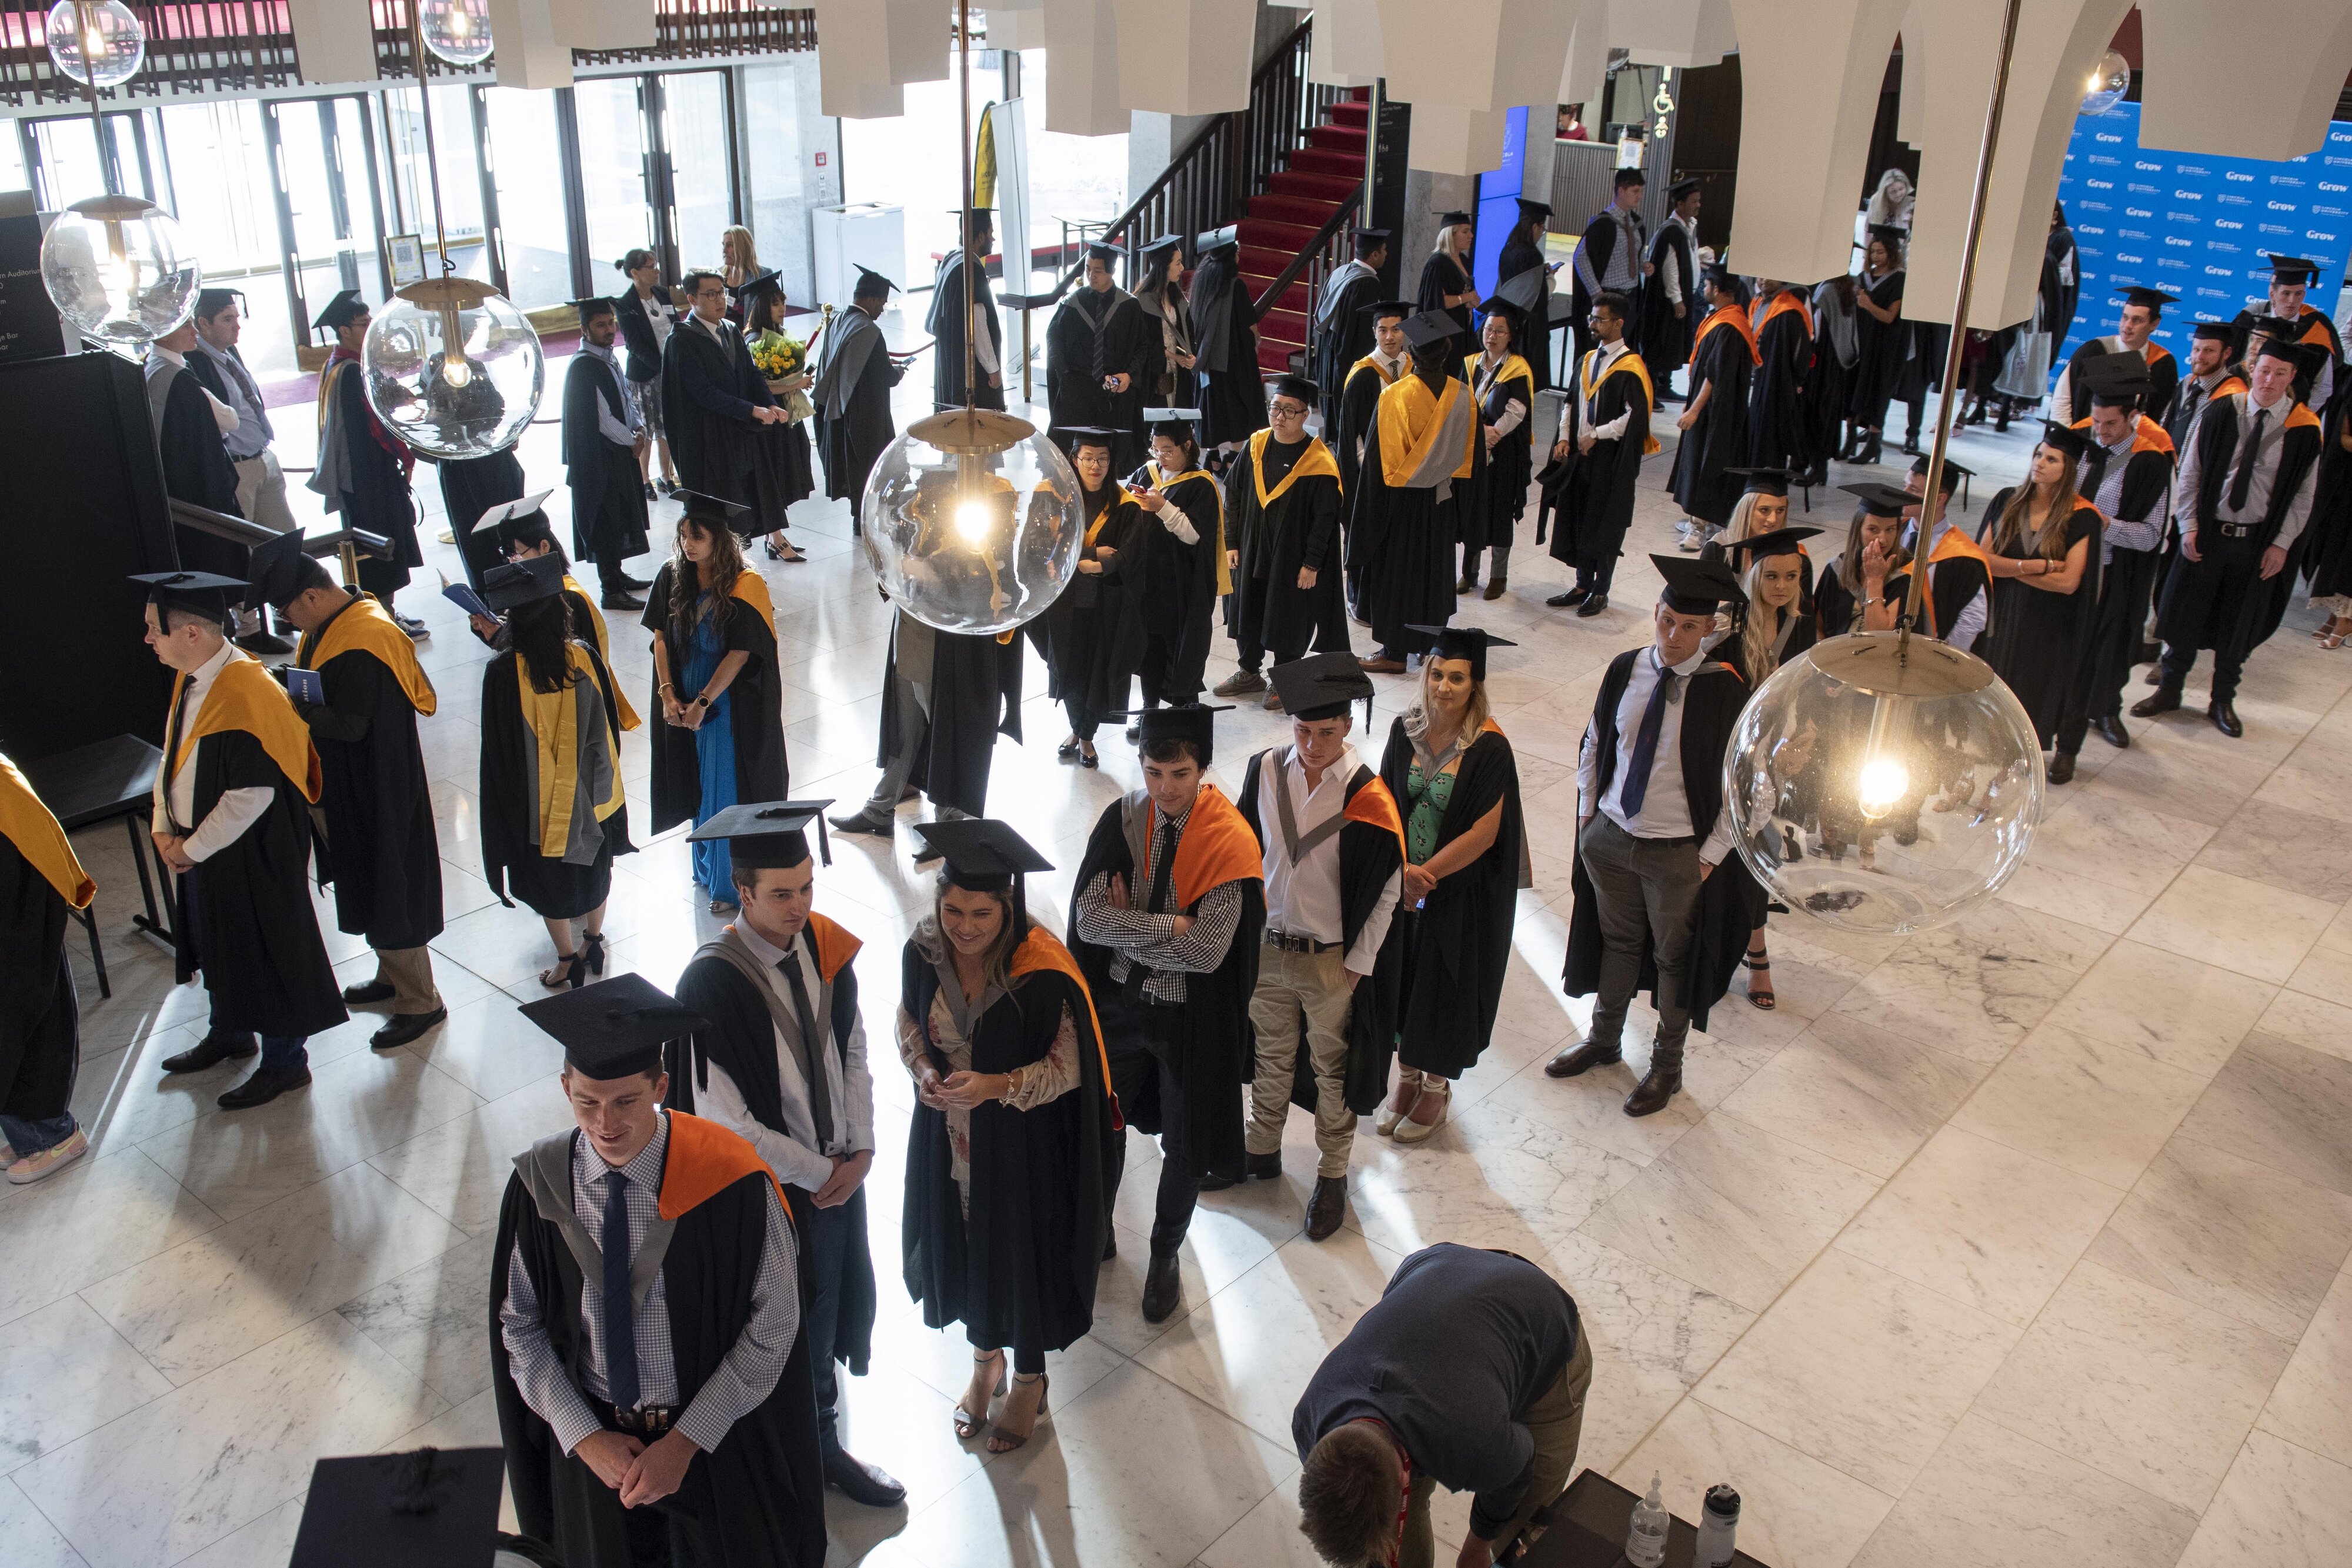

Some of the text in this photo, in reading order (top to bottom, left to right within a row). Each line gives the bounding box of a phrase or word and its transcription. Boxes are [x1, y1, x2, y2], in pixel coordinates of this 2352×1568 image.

[2096, 132, 2123, 143] Grow
[2330, 132, 2352, 142] Gro
[2135, 161, 2163, 171] Grow
[2226, 171, 2256, 182] Grow
[2087, 178, 2114, 189] Grow
[2318, 181, 2349, 192] Grow
[2175, 189, 2204, 200] Grow
[2267, 201, 2297, 212] Grow
[2126, 207, 2153, 218] Grow
[2215, 218, 2244, 229] Grow
[2079, 224, 2105, 235] Grow
[2306, 230, 2337, 241] Grow
[2165, 236, 2193, 247] Grow
[2117, 253, 2144, 263] Grow
[2205, 265, 2233, 276] Grow
[2156, 282, 2183, 293] Grow
[2107, 297, 2126, 308] Gro
[2245, 295, 2270, 303] Gro
[2194, 312, 2223, 322] Grow
[2152, 330, 2174, 338] row
